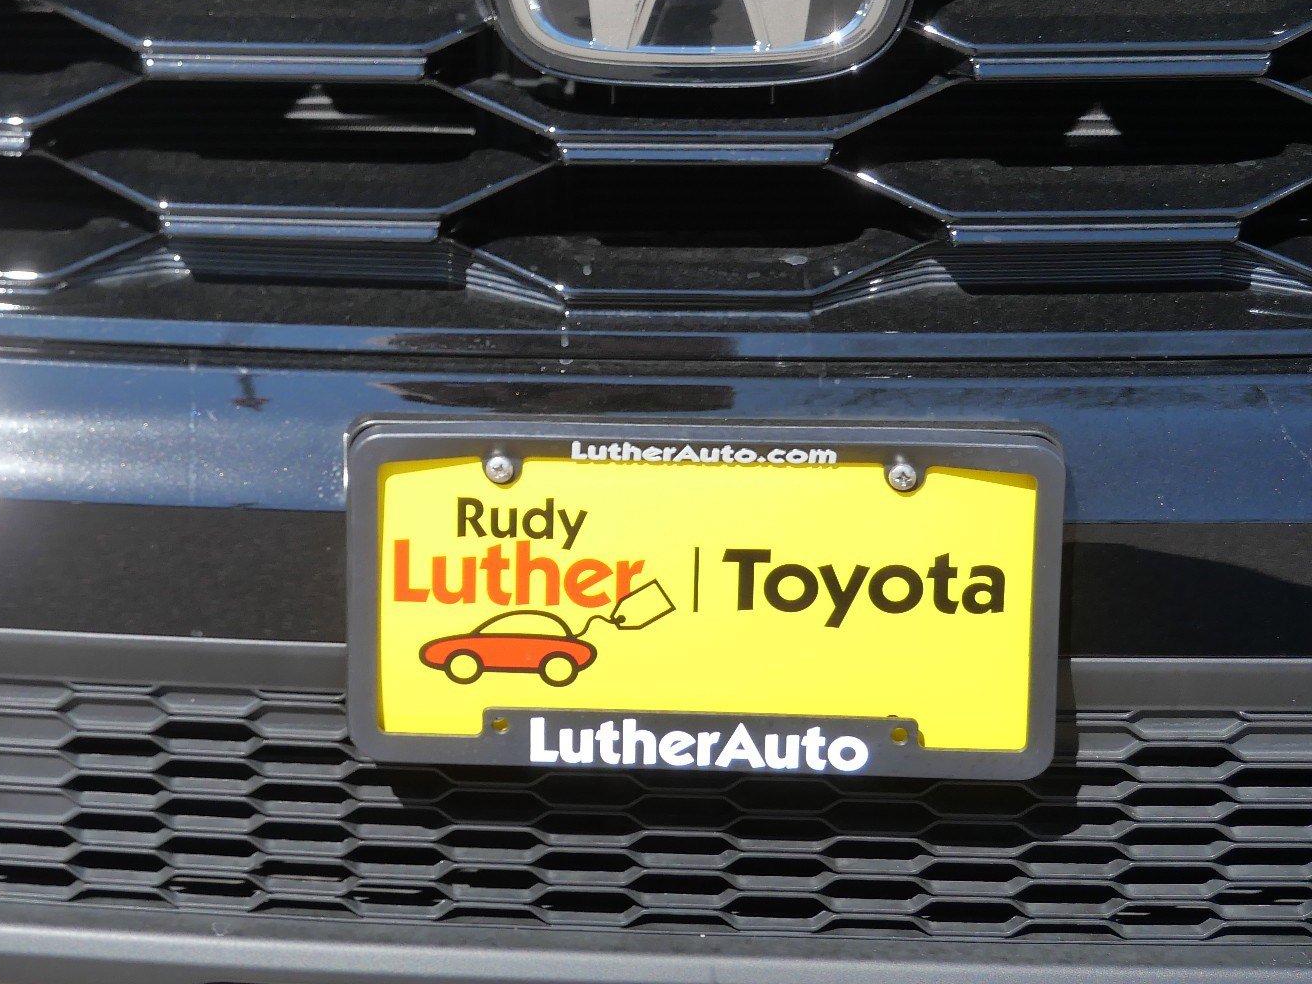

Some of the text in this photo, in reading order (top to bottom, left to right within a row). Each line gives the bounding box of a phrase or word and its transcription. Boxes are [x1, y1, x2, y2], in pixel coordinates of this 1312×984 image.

[571, 440, 838, 465] LutherAuto.com
[456, 497, 588, 550] Rudy
[393, 539, 646, 608] Luther
[722, 548, 1006, 628] Toyota
[529, 717, 870, 772] LutherAuto
